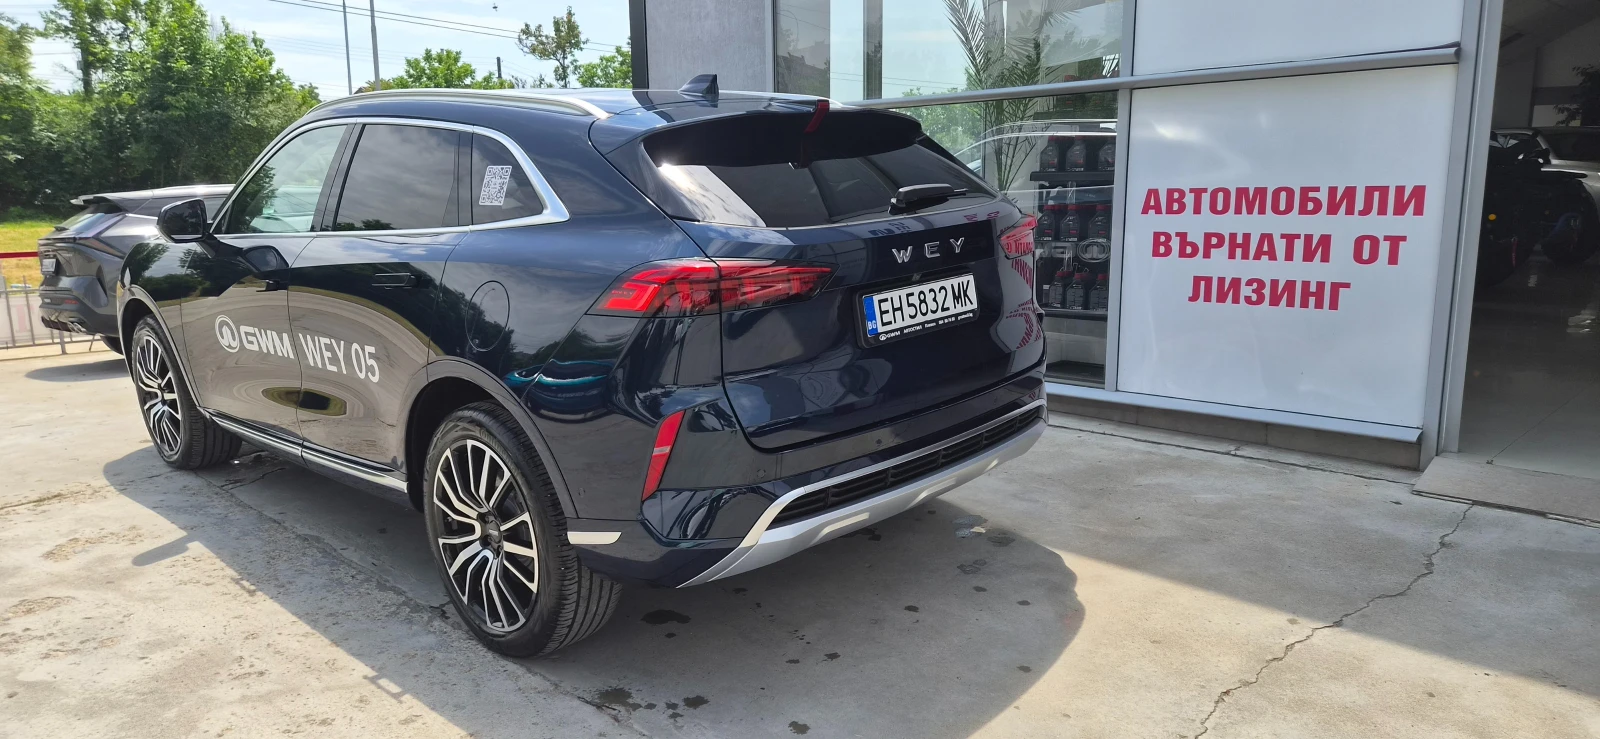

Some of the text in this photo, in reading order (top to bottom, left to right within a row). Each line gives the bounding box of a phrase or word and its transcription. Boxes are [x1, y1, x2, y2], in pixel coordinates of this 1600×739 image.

[1141, 185, 1426, 216] АВТОМОБИЛИ
[892, 237, 965, 264] WEY
[1152, 231, 1407, 265] ВЪРНАТИ ОТ
[1188, 275, 1351, 310] ЛИЗИНГ
[868, 320, 877, 330] BG
[240, 325, 380, 383] GWM WEY 05
